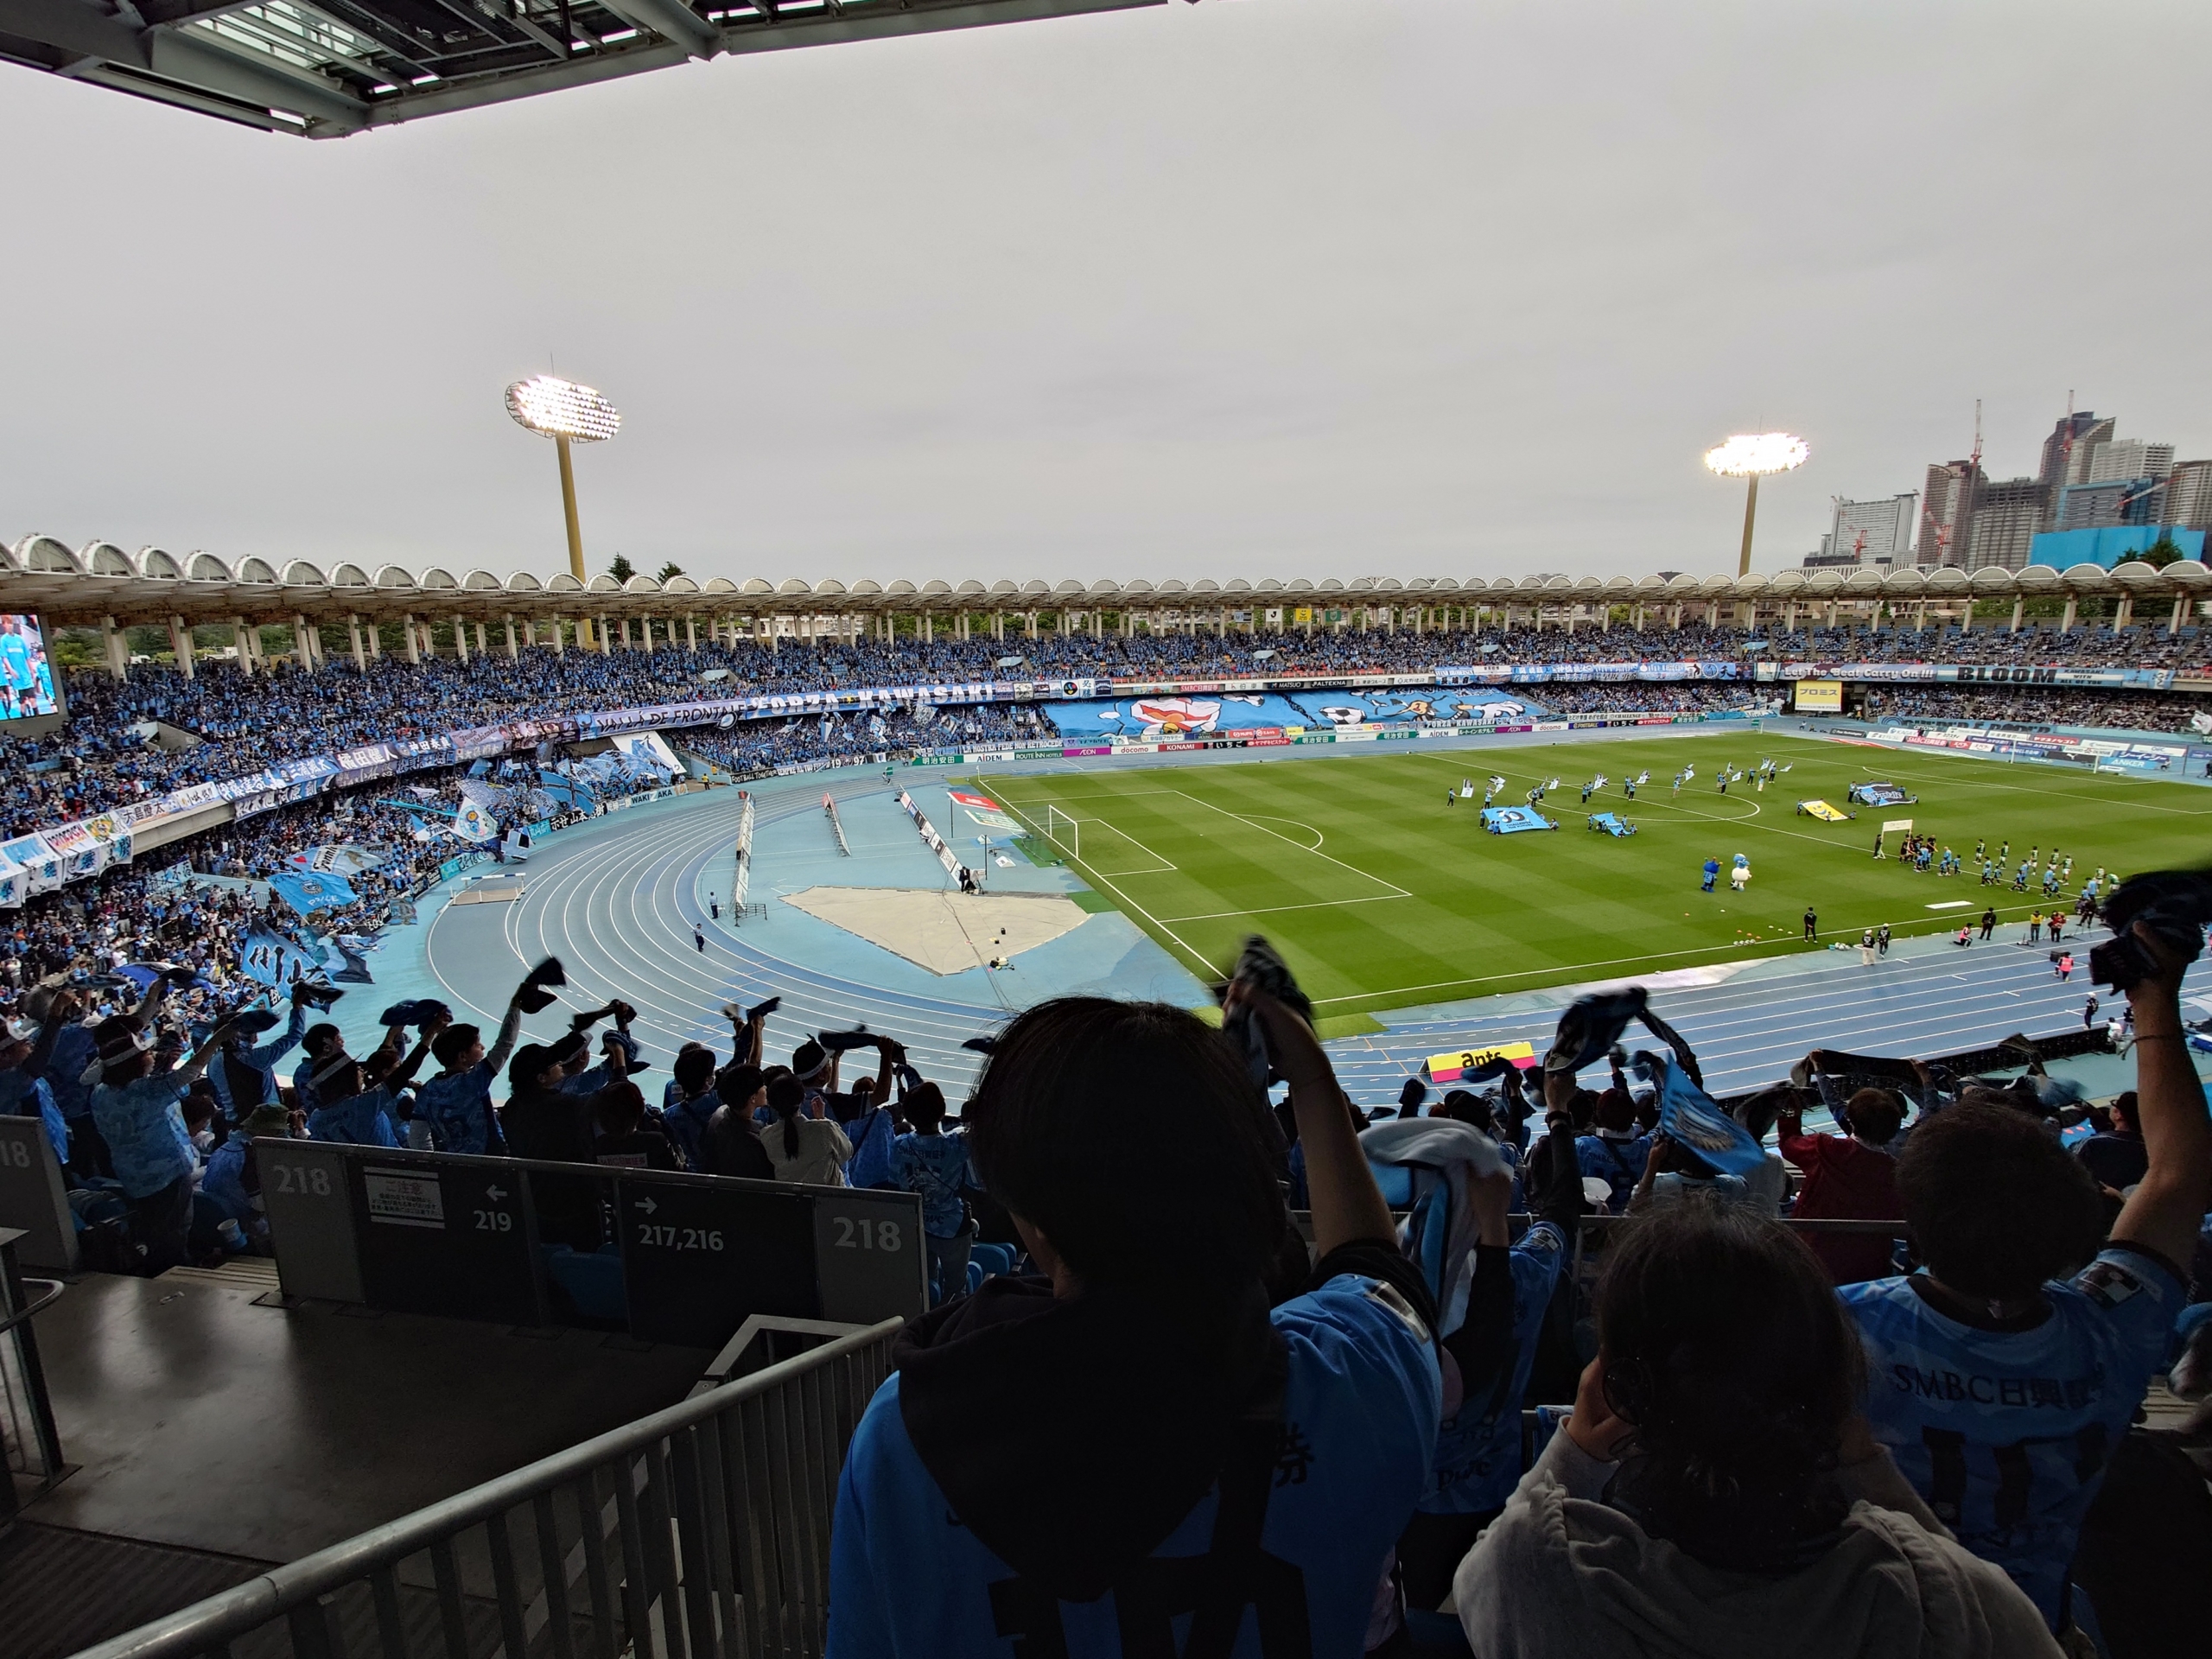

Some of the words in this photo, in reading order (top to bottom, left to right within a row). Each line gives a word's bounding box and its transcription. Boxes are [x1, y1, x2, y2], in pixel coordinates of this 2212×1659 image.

[1784, 667, 1802, 677] Let
[1806, 666, 1827, 677] The
[1830, 667, 1859, 677] Beat
[1864, 668, 1898, 680] Carry
[1901, 669, 1918, 678] On
[1957, 666, 2057, 683] BLOOM
[858, 683, 994, 709] KAWASAKI
[649, 711, 670, 726] DE
[963, 745, 971, 753] LA
[1015, 751, 1034, 760] ROUTE
[831, 758, 842, 768] 19
[854, 756, 865, 766] 97
[922, 756, 955, 765] 明治安田
[2110, 759, 2145, 768] ANKER
[731, 772, 754, 783] FOOTBALL
[0, 1140, 30, 1168] 18
[272, 1165, 332, 1197] 218
[474, 1209, 512, 1233] 219
[638, 1224, 725, 1253] 217,216
[833, 1216, 902, 1253] 218
